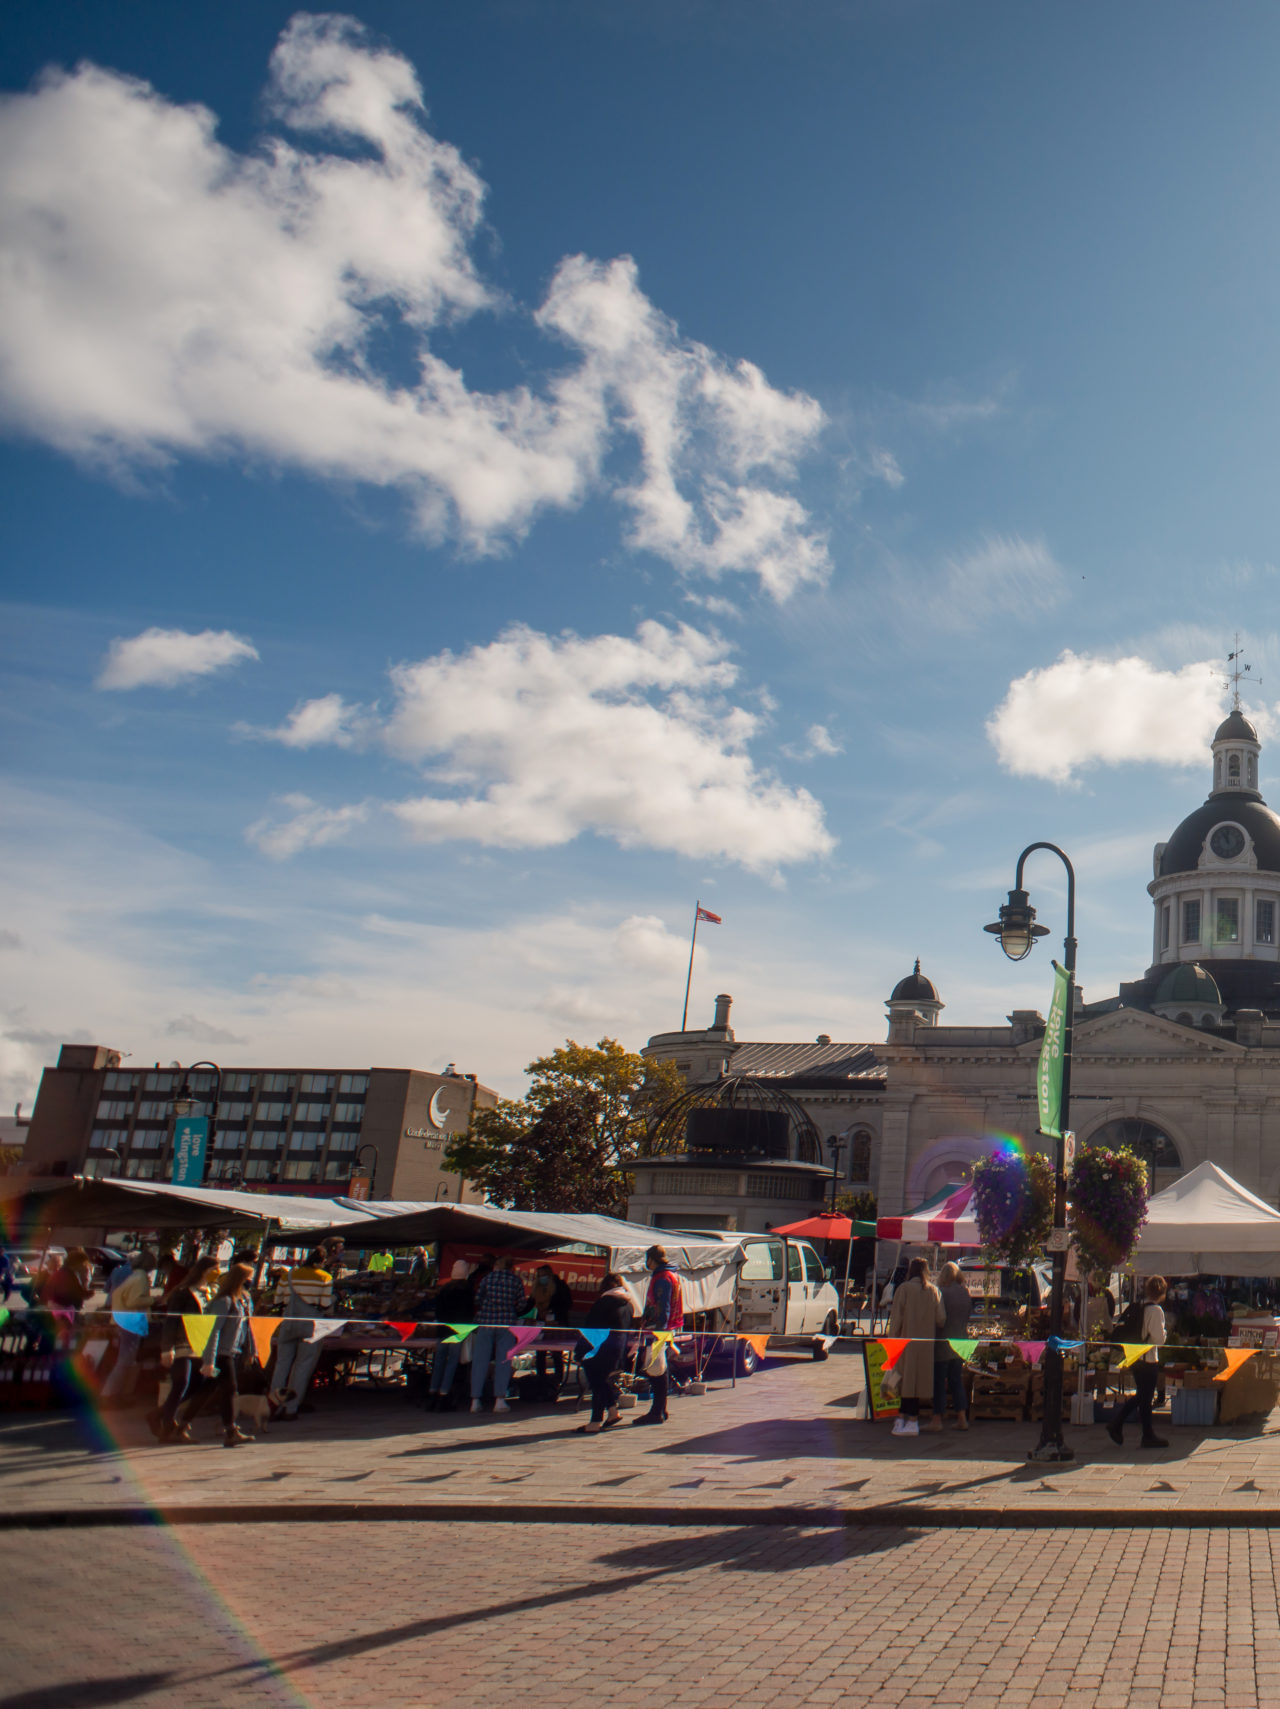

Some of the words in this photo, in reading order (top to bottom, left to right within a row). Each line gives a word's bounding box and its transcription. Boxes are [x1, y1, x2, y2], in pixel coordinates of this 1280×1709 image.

[1051, 1008, 1064, 1058] love
[1042, 1005, 1059, 1114] Kingston
[177, 1135, 191, 1181] Kingston
[192, 1134, 203, 1157] love
